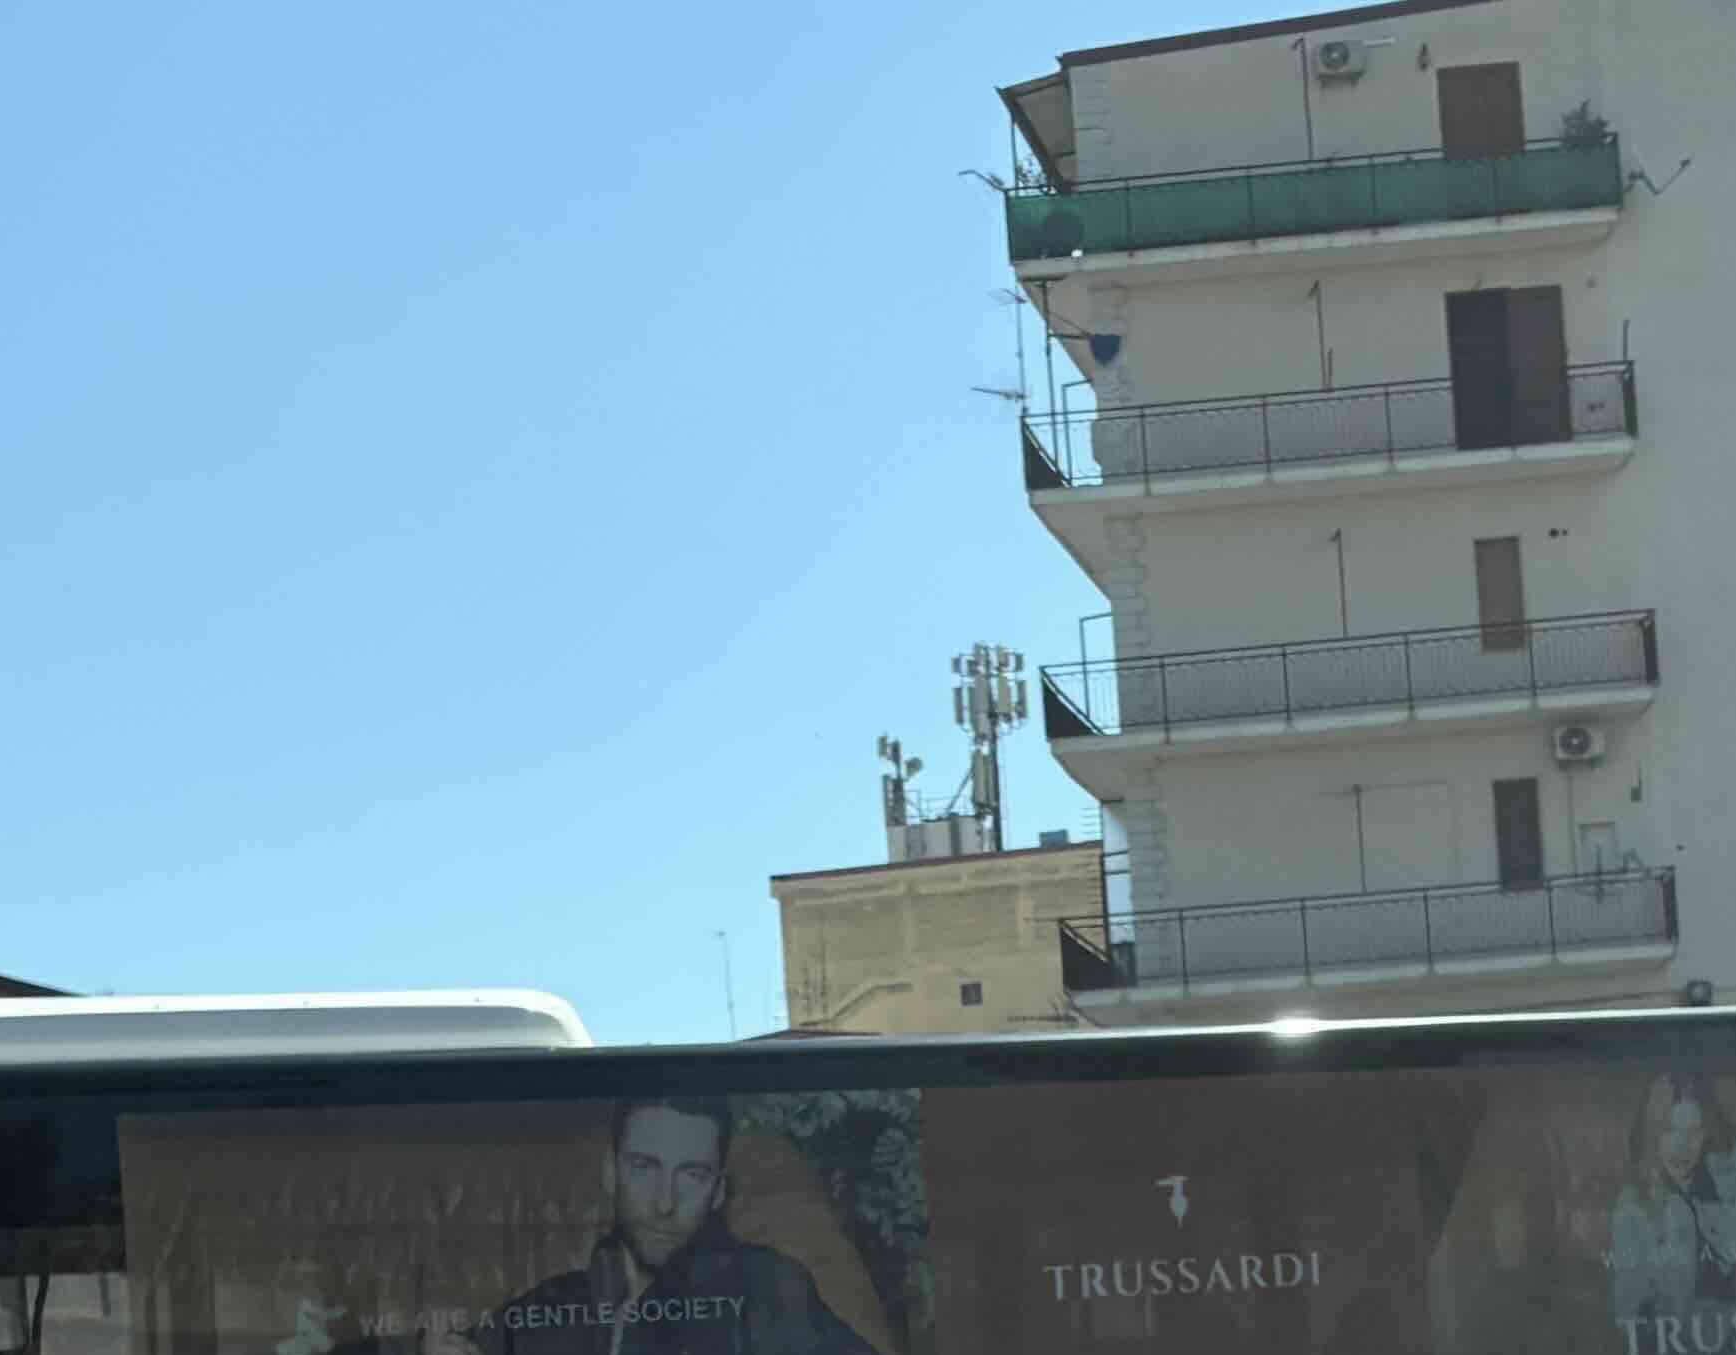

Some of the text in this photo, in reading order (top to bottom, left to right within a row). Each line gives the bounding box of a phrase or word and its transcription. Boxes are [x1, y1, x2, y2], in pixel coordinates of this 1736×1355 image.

[1043, 1251, 1321, 1300] TRUSSARDI
[359, 1296, 746, 1336] WE ARE A GENTLE SOCIETY
